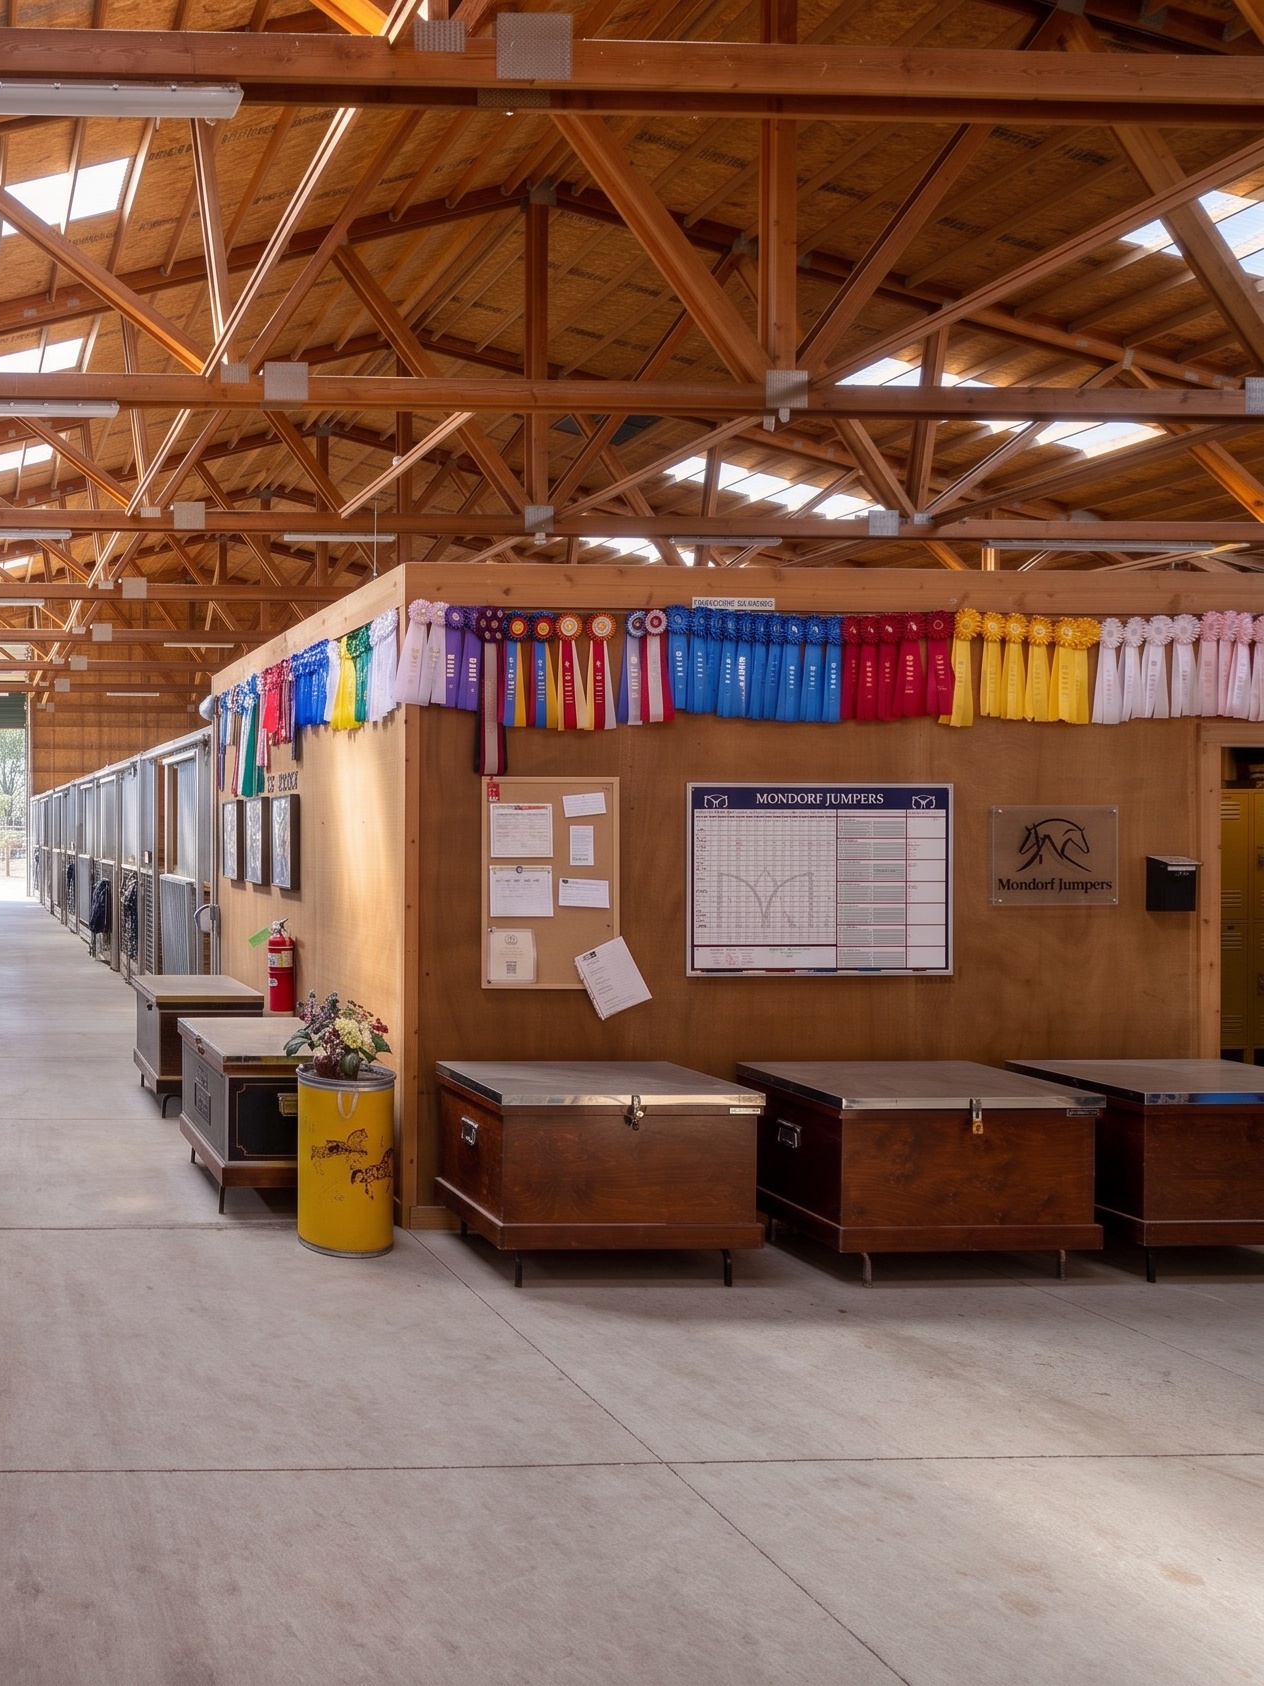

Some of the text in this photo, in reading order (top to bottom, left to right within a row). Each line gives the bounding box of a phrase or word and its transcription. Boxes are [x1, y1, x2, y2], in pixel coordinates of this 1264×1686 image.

[755, 792, 885, 807] MONDORF JUMPERS
[997, 878, 1113, 894] Mondorf Jumpers
